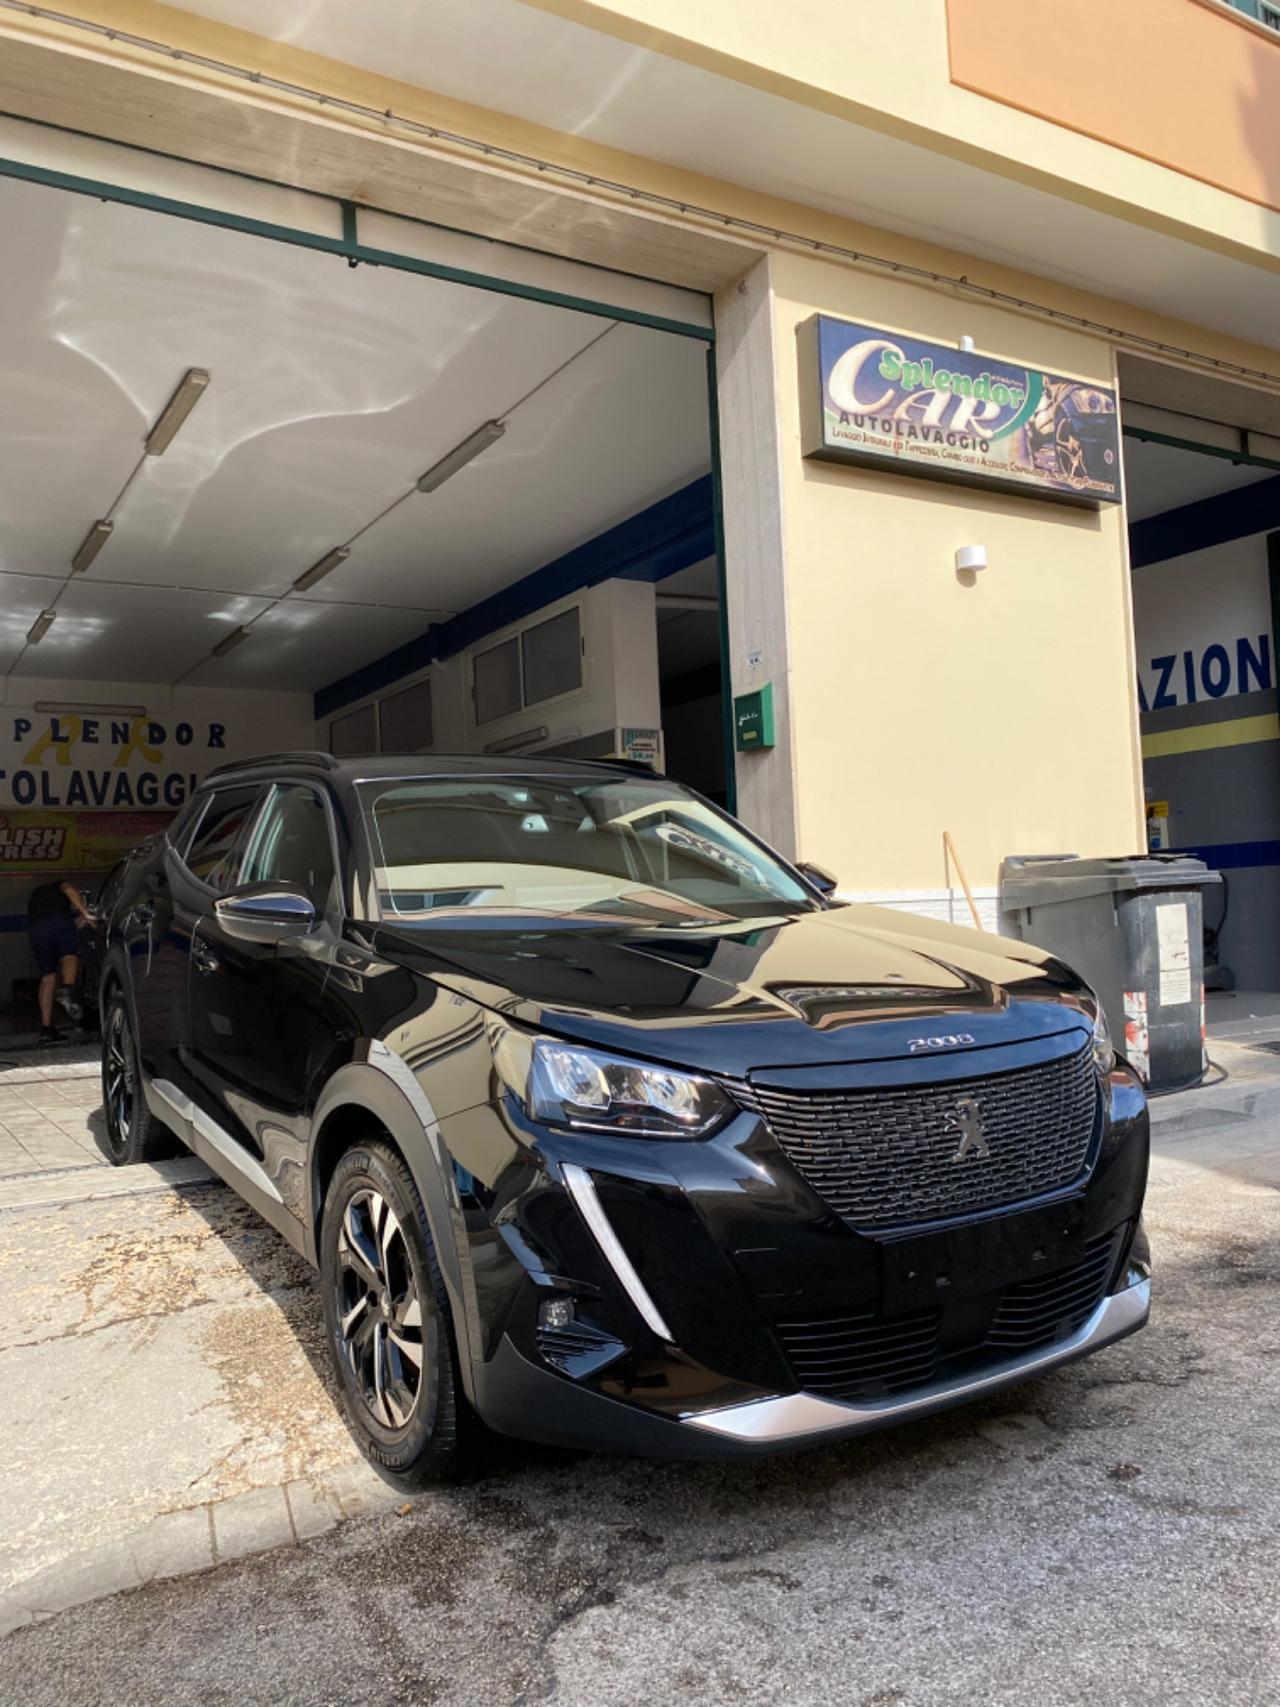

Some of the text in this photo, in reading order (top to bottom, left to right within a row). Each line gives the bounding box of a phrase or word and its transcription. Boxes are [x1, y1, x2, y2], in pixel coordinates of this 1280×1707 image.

[879, 350, 1025, 410] Splendor
[839, 411, 991, 454] AUTOLAVAGGIO
[13, 717, 227, 749] PLENDOR
